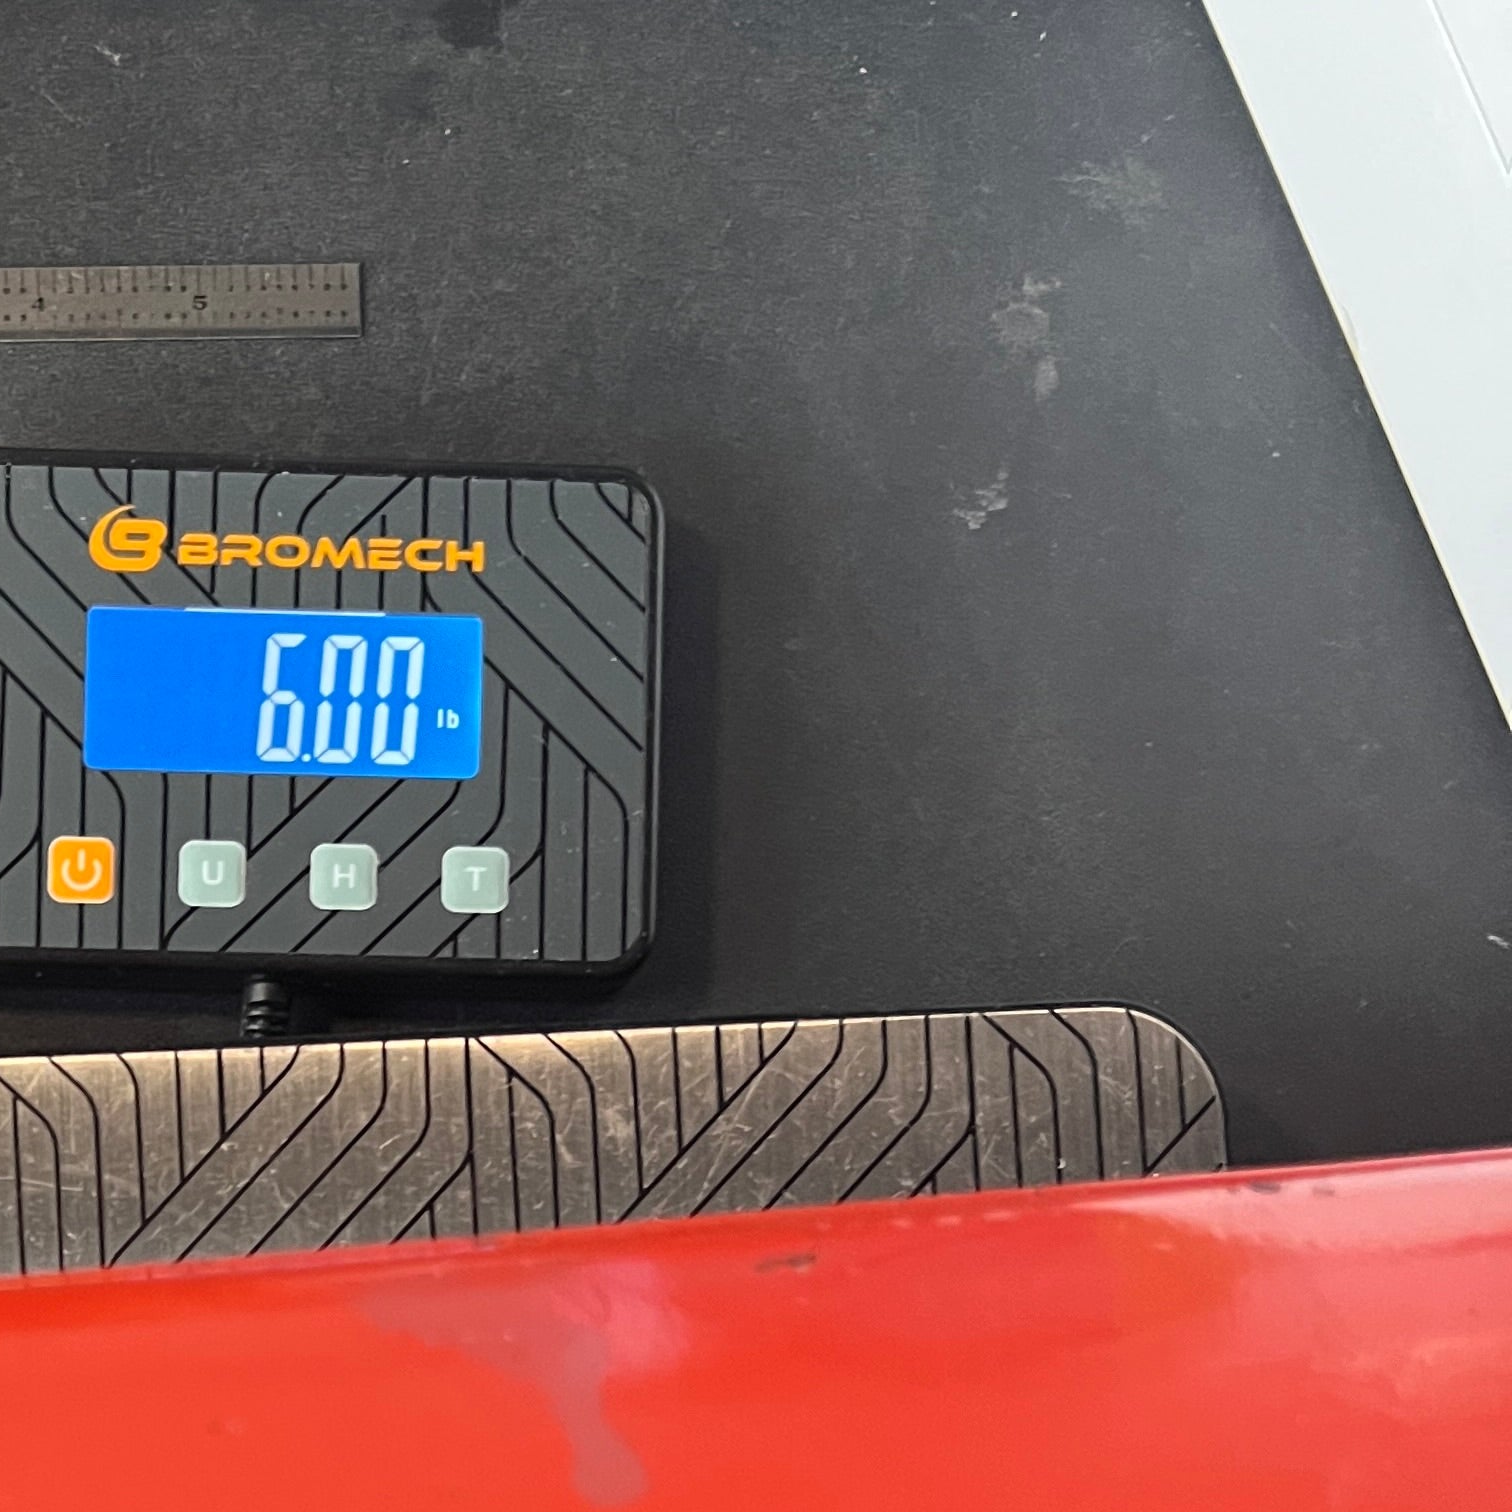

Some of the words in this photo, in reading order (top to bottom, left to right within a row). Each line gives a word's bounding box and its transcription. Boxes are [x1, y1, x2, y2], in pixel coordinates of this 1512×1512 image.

[30, 296, 45, 313] 4
[192, 295, 208, 311] 5
[177, 532, 486, 573] BROMECH
[256, 633, 426, 766] 6.00
[437, 708, 460, 729] lb
[201, 860, 225, 886] U
[332, 863, 357, 889] H
[462, 865, 488, 892] T
